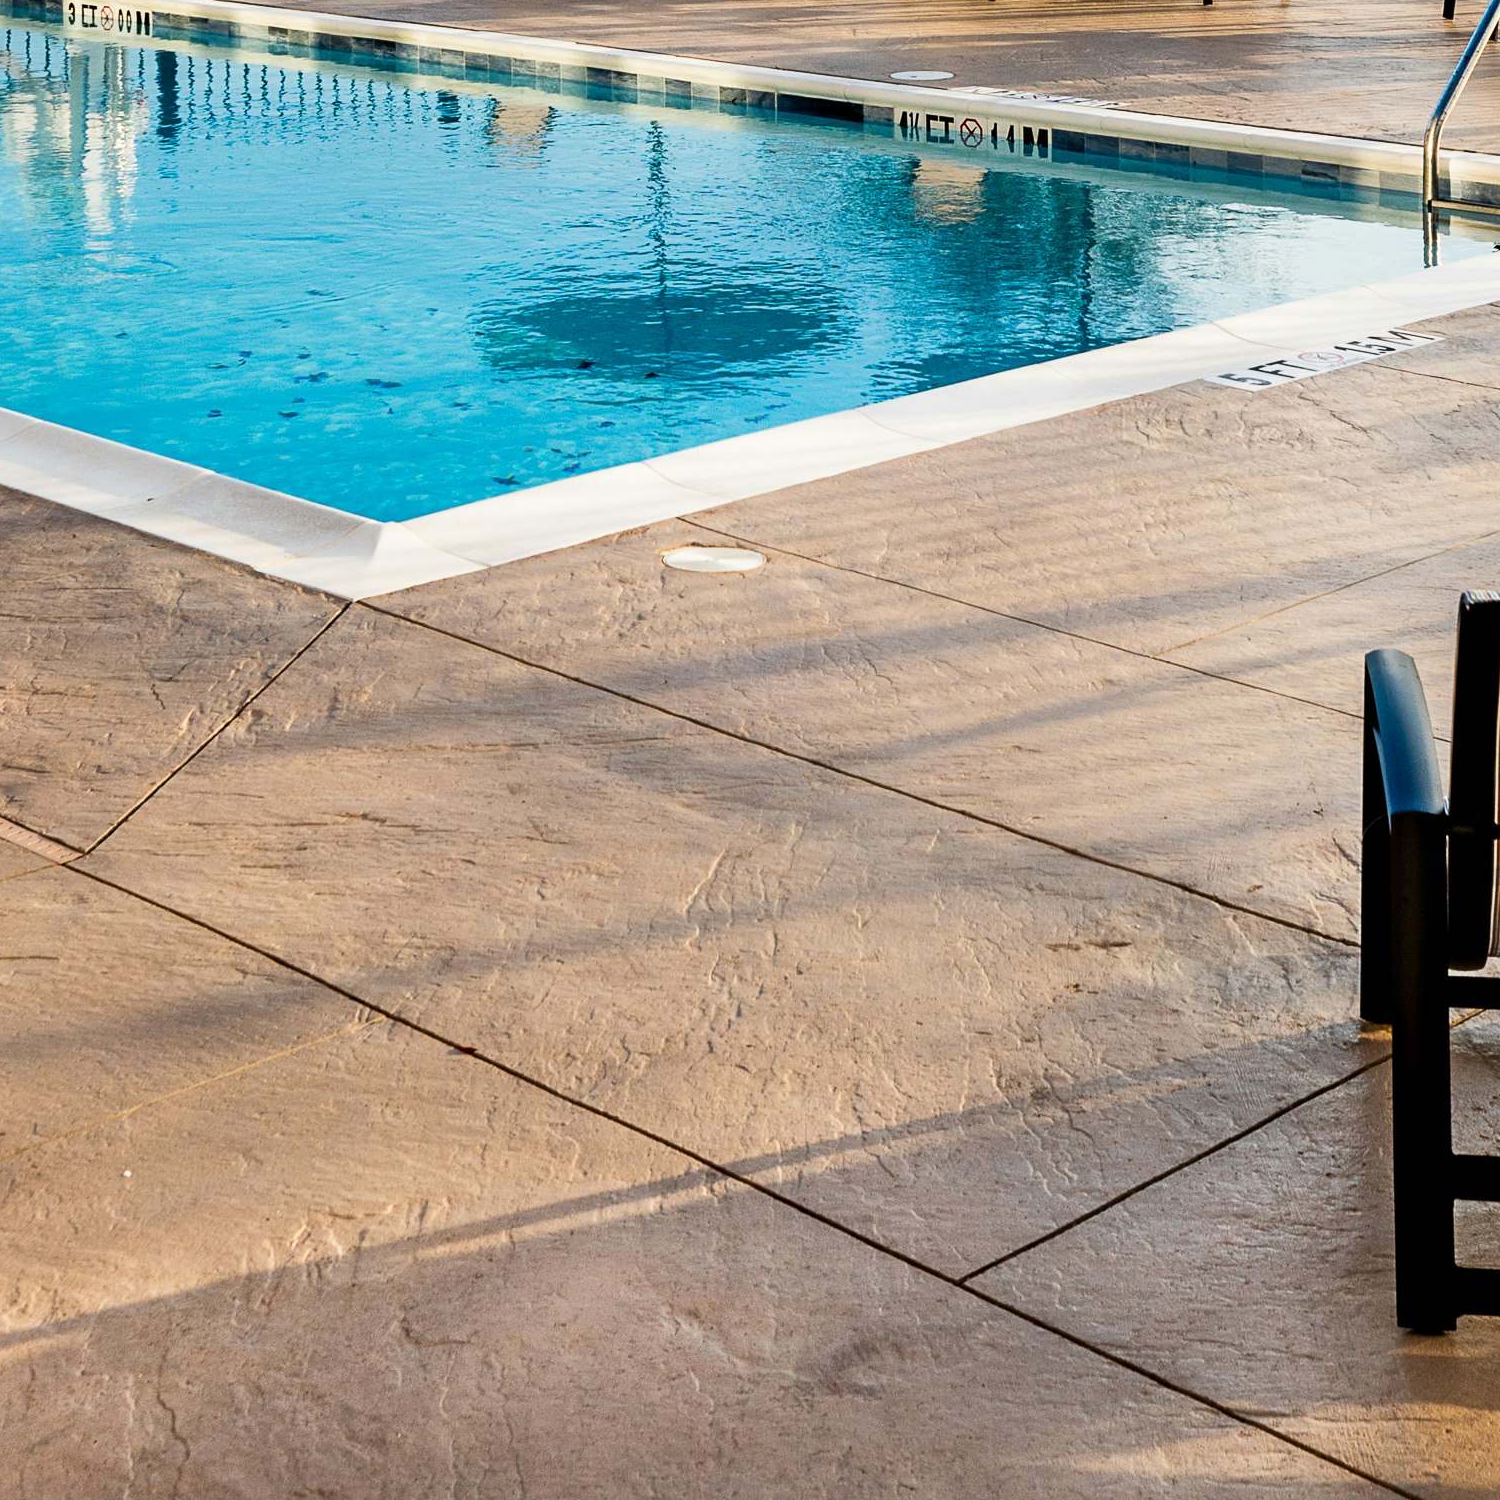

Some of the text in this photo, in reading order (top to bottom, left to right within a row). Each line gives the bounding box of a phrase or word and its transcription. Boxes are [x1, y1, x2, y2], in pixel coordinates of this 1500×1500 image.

[1218, 373, 1272, 386] 5
[1248, 360, 1319, 379] FT
[1367, 330, 1435, 347] M
